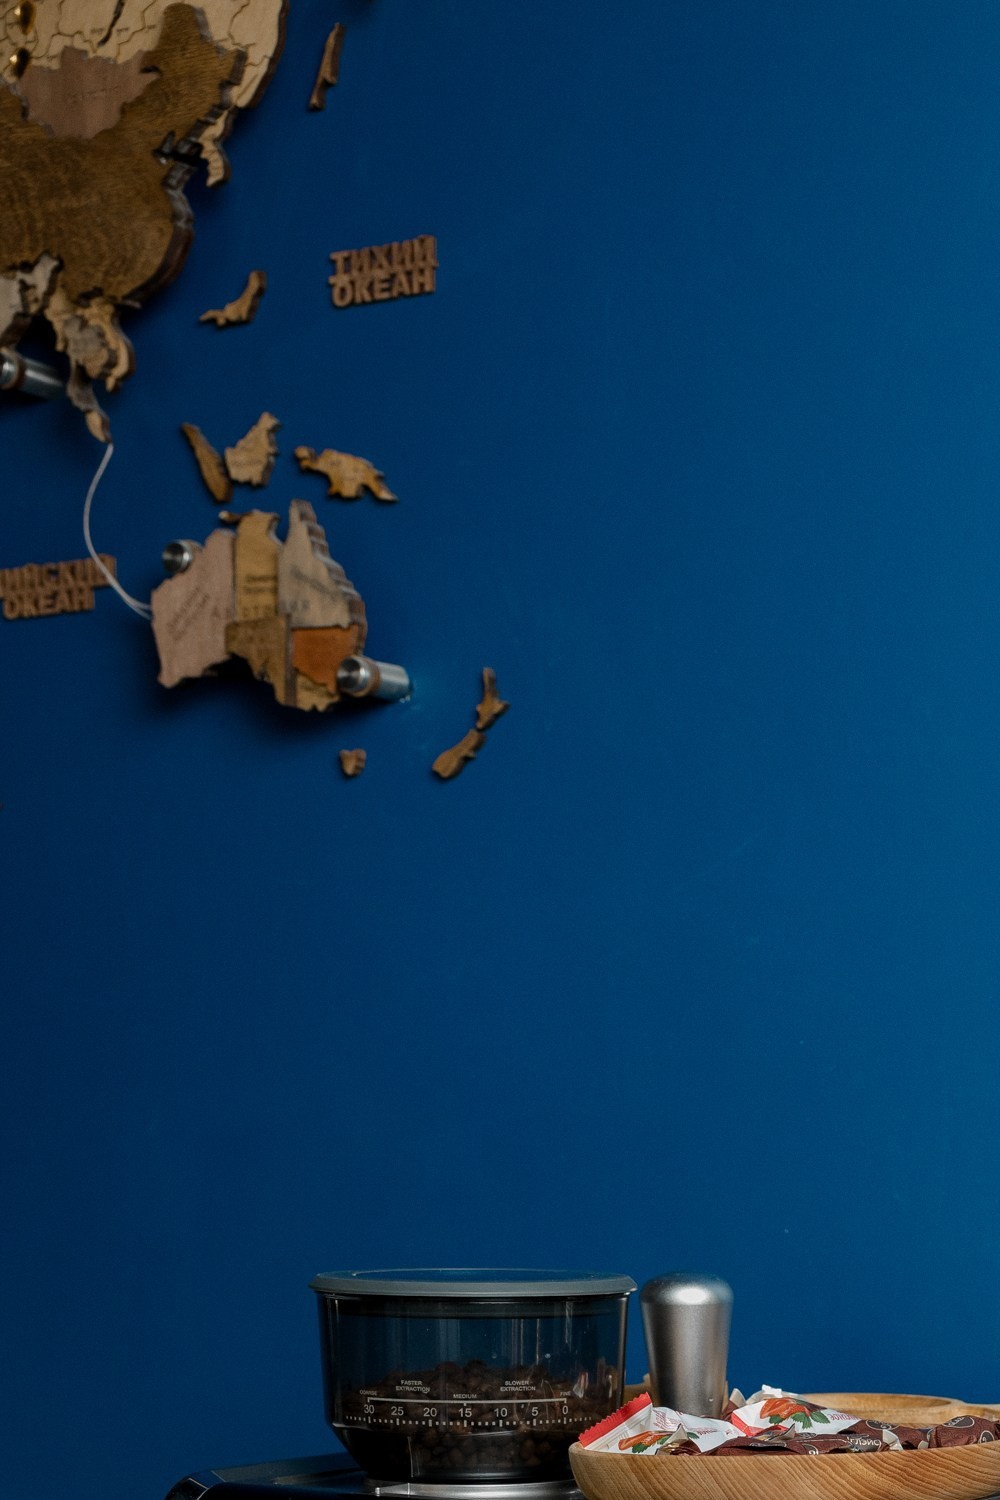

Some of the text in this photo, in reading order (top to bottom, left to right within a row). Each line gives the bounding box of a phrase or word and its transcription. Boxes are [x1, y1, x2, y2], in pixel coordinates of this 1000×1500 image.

[330, 269, 436, 308] ОКЕАН
[3, 582, 95, 620] ОКЕАН
[395, 1385, 431, 1393] EXTRACTION
[363, 1404, 569, 1418] 30 25 20 15 10 5 0
